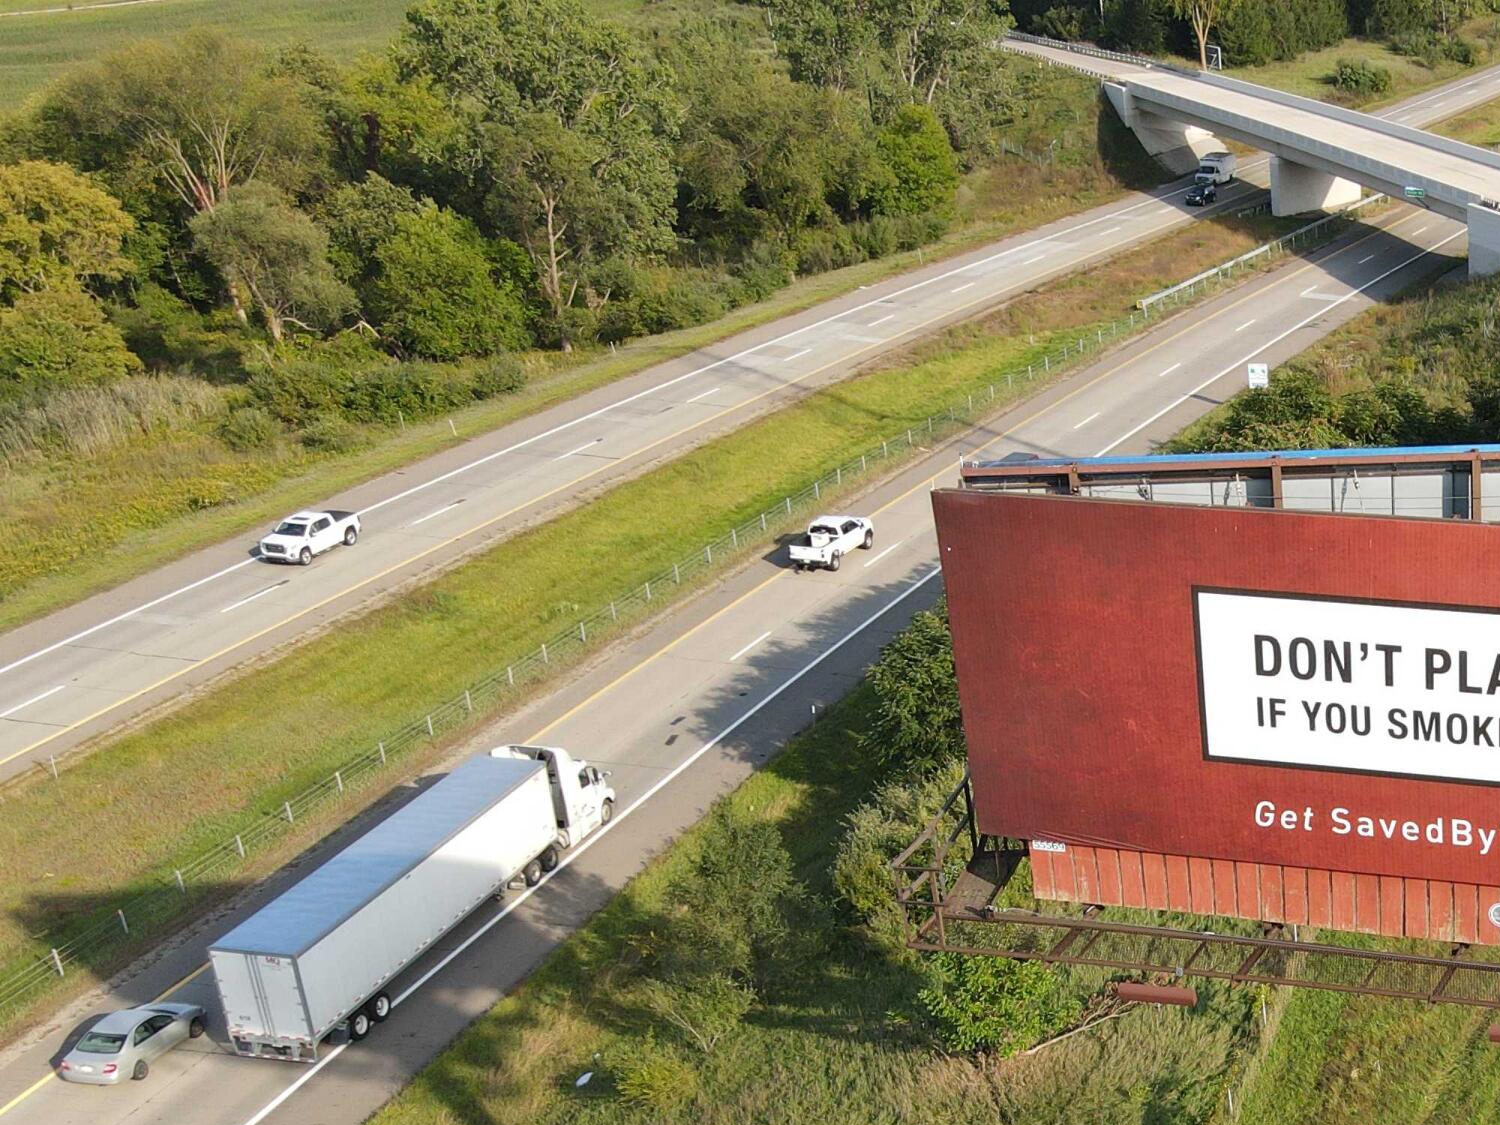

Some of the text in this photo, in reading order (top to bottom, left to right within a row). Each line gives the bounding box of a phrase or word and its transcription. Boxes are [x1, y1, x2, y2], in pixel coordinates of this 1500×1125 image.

[1254, 634, 1402, 687] DON'T
[1256, 696, 1287, 728] IF
[1301, 700, 1371, 736] YOU
[1255, 800, 1314, 832] Get
